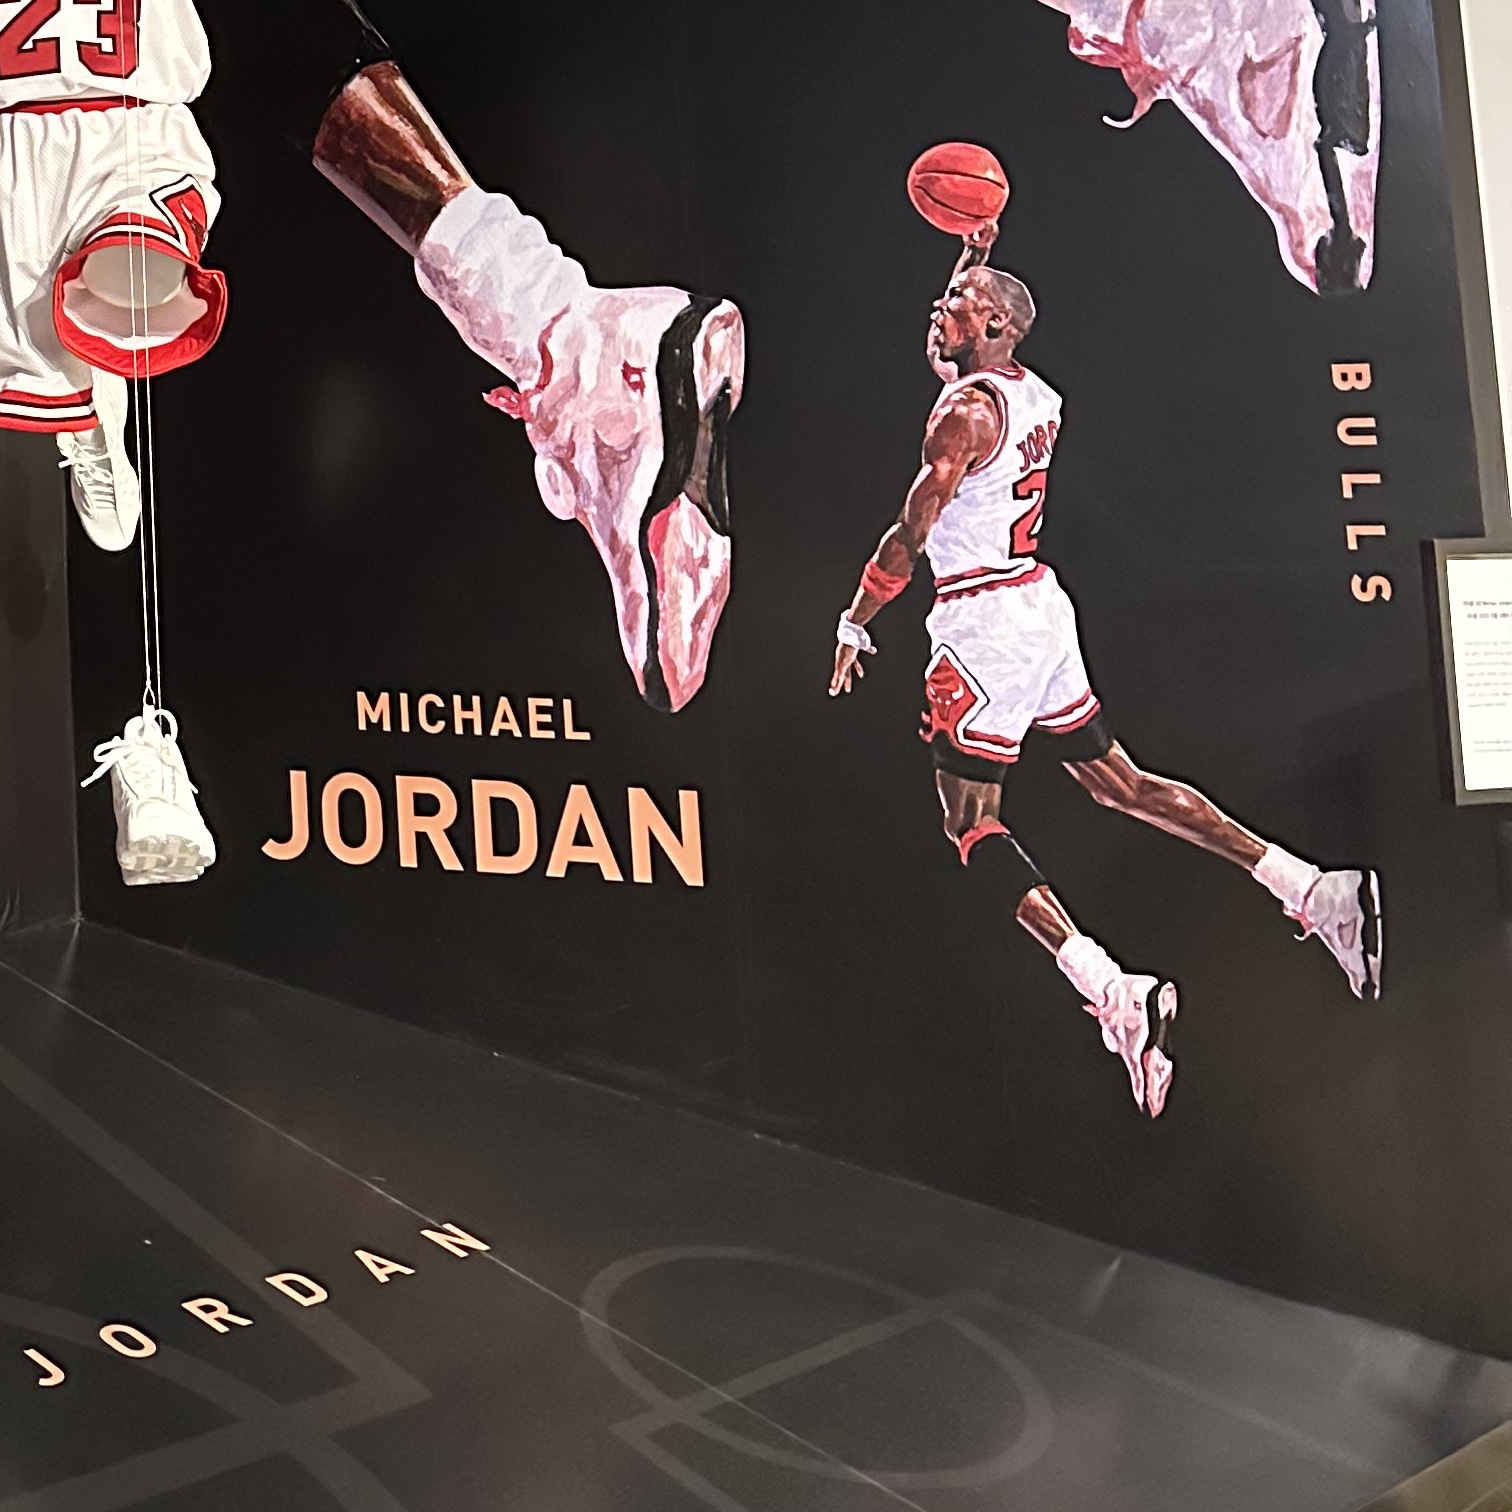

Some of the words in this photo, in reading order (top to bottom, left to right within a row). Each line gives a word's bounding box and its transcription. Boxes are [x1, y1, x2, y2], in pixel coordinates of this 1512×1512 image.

[1330, 362, 1393, 603] BULLS
[355, 690, 591, 741] MICHAEL
[261, 769, 705, 887] JORDAN
[22, 1221, 491, 1387] JORDAN
